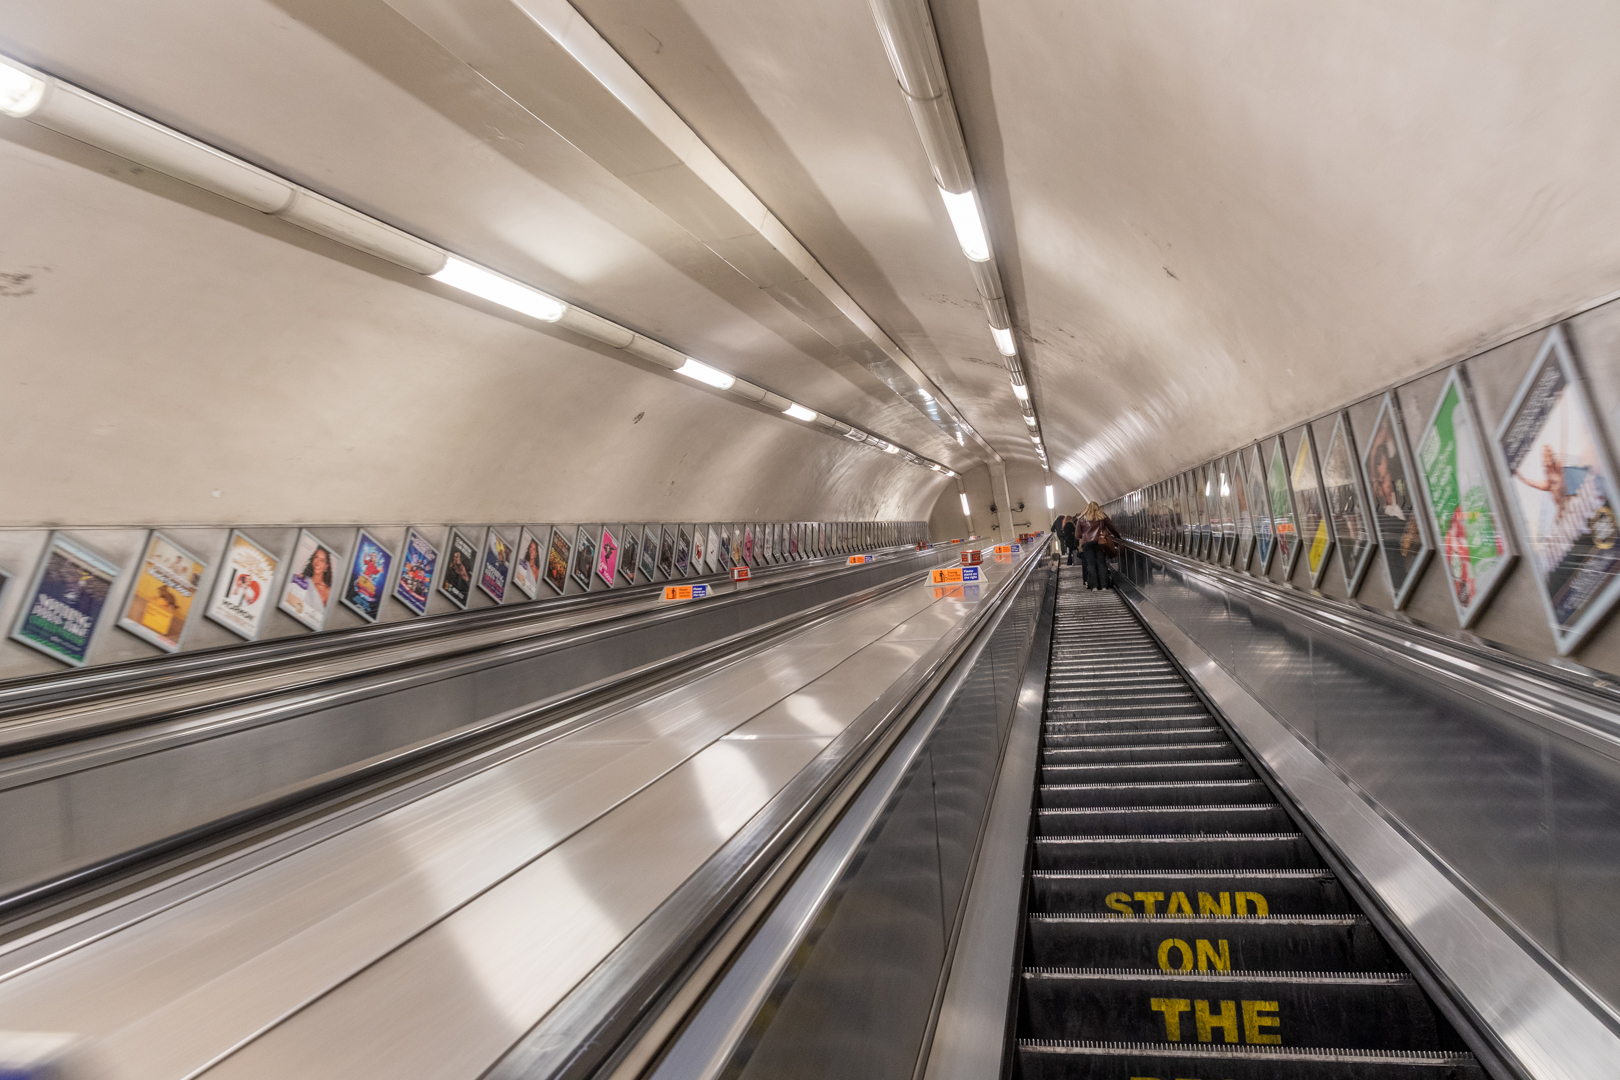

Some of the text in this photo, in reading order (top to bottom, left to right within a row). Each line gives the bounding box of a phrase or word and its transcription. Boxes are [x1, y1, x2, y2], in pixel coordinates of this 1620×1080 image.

[1105, 891, 1269, 918] STAND
[1157, 938, 1231, 976] ON
[1150, 997, 1282, 1045] THE
